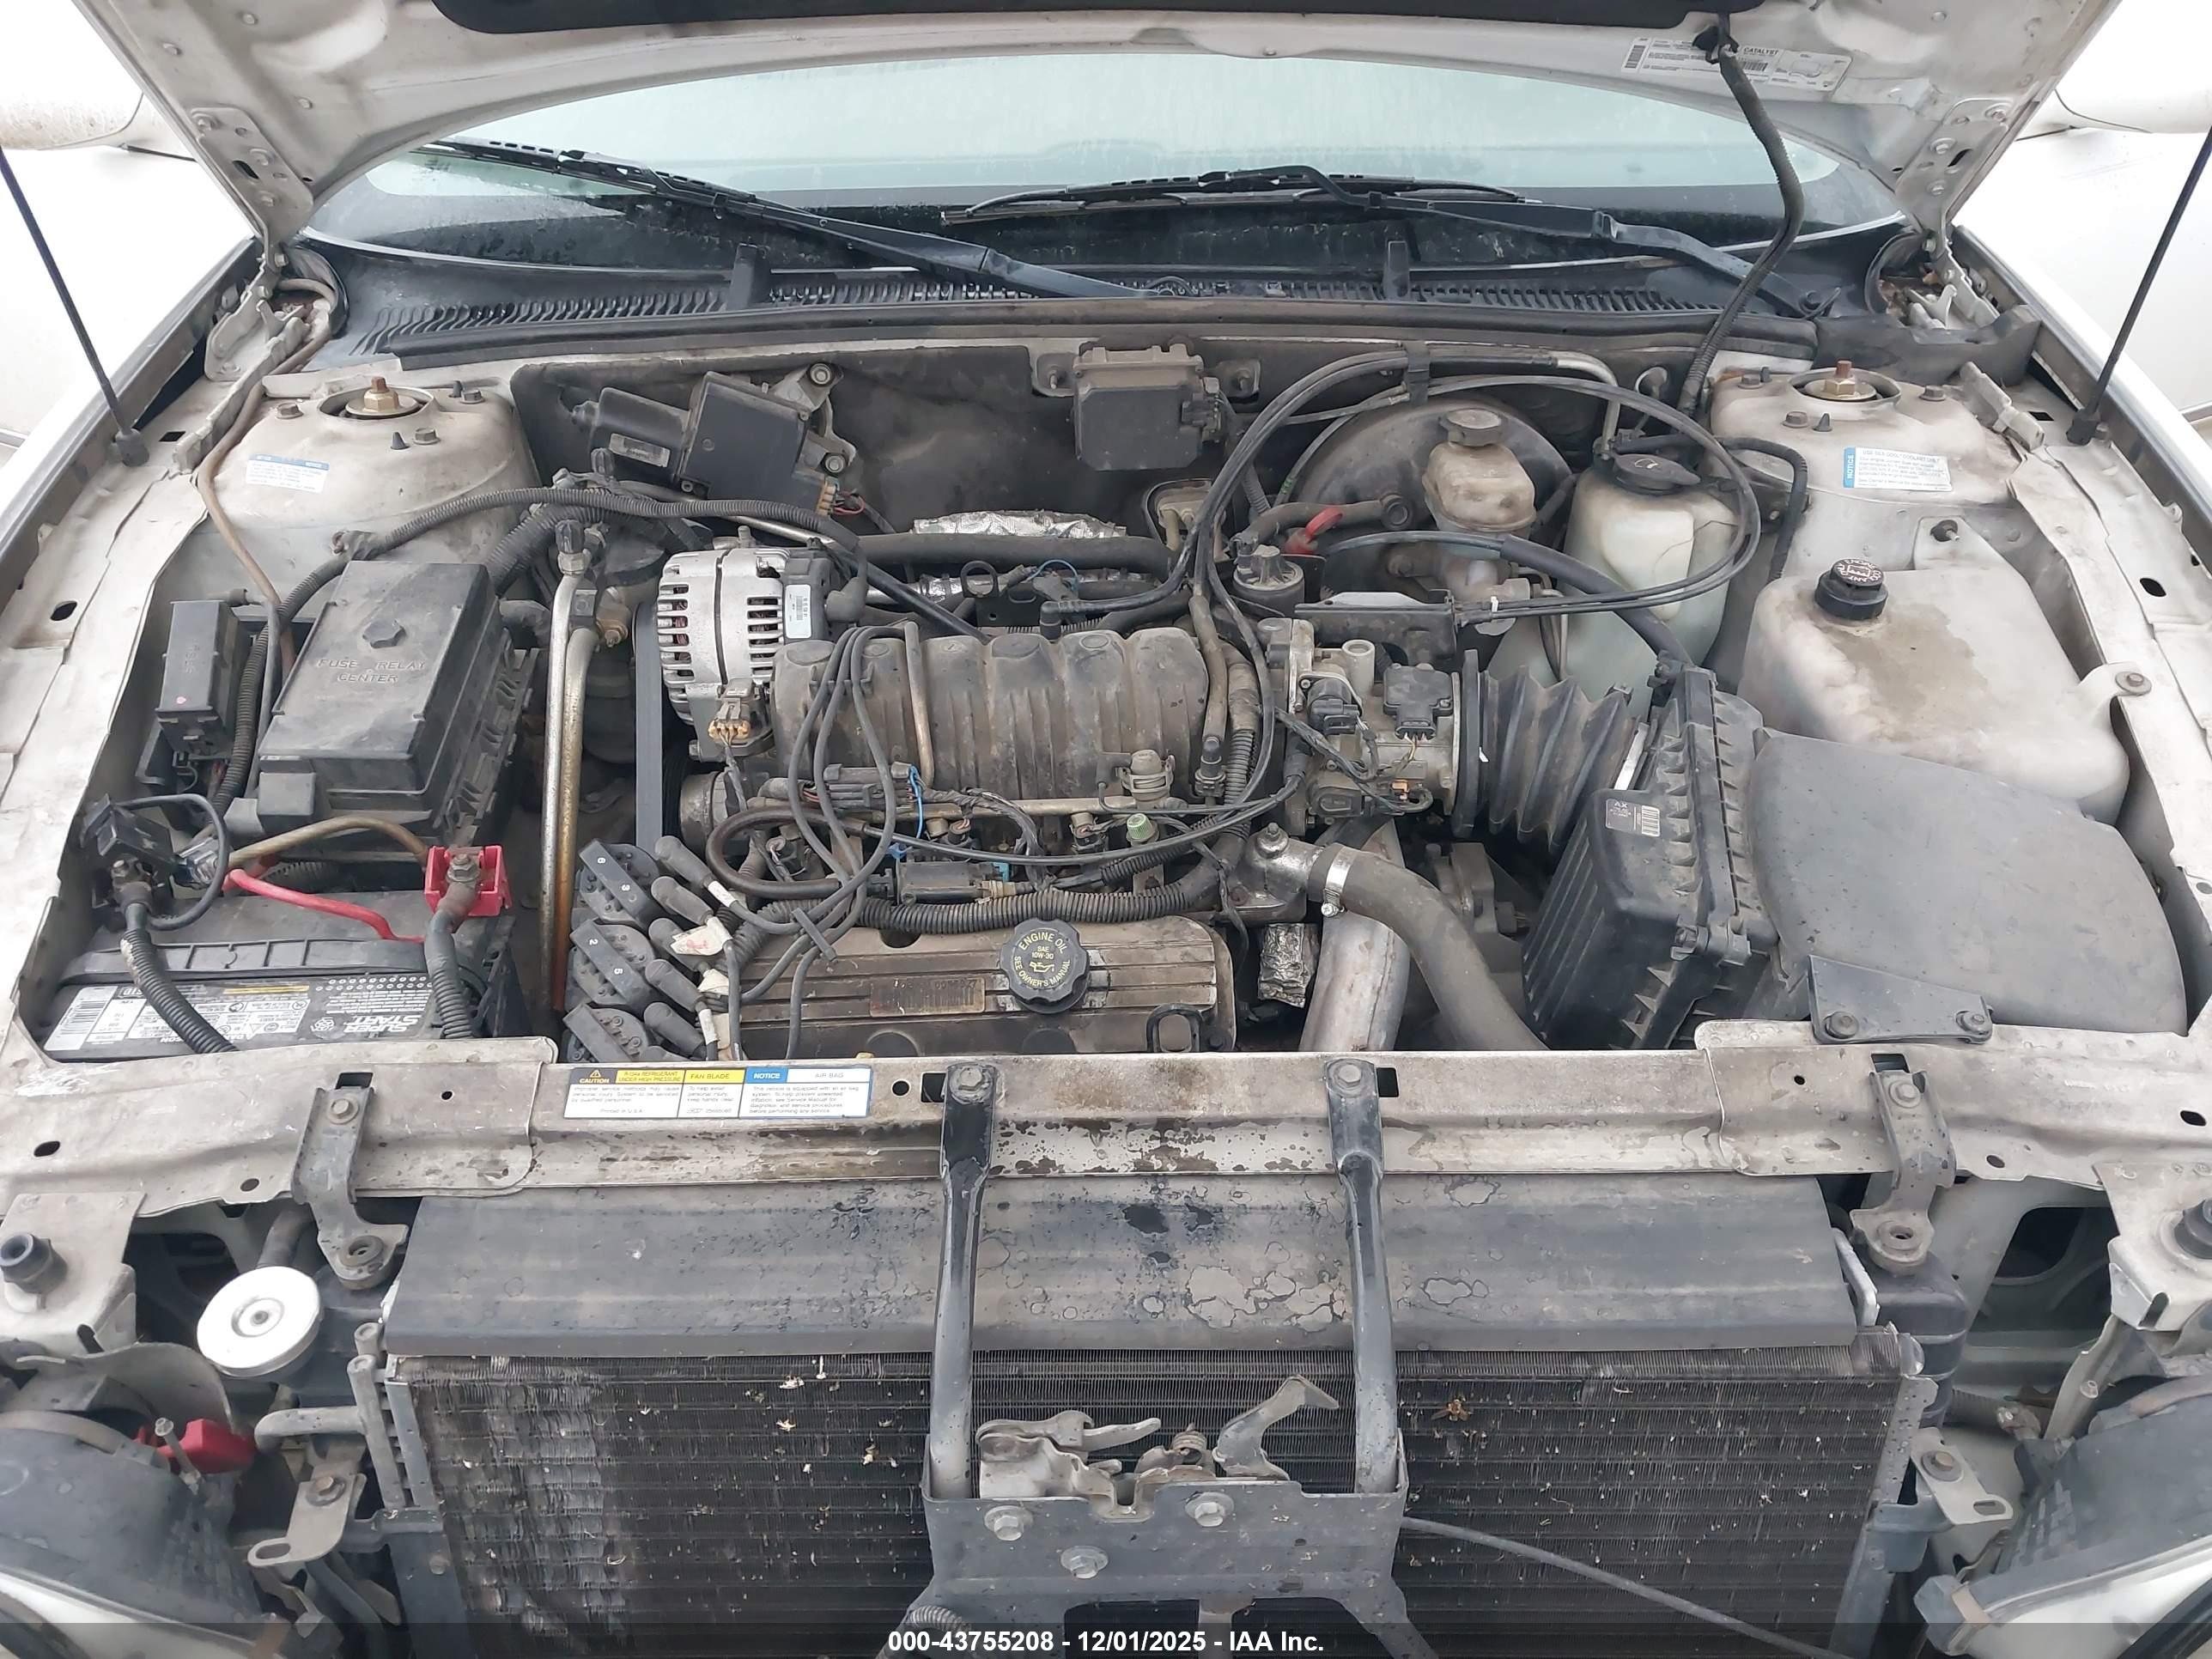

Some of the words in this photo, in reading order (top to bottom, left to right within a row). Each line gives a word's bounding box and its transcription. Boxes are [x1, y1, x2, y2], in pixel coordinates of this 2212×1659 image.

[316, 659, 358, 670] FUSE
[374, 660, 427, 672] RELAY
[337, 672, 399, 684] CENTER
[1018, 932, 1055, 951] ENGINE
[1054, 938, 1068, 954] OIL
[1031, 951, 1054, 960] 10W-30
[1013, 956, 1024, 970] SEE
[1018, 970, 1050, 987] OWNER'S
[1049, 959, 1071, 986] MANUAL
[352, 1015, 422, 1025] START
[343, 1024, 408, 1033] SUPER
